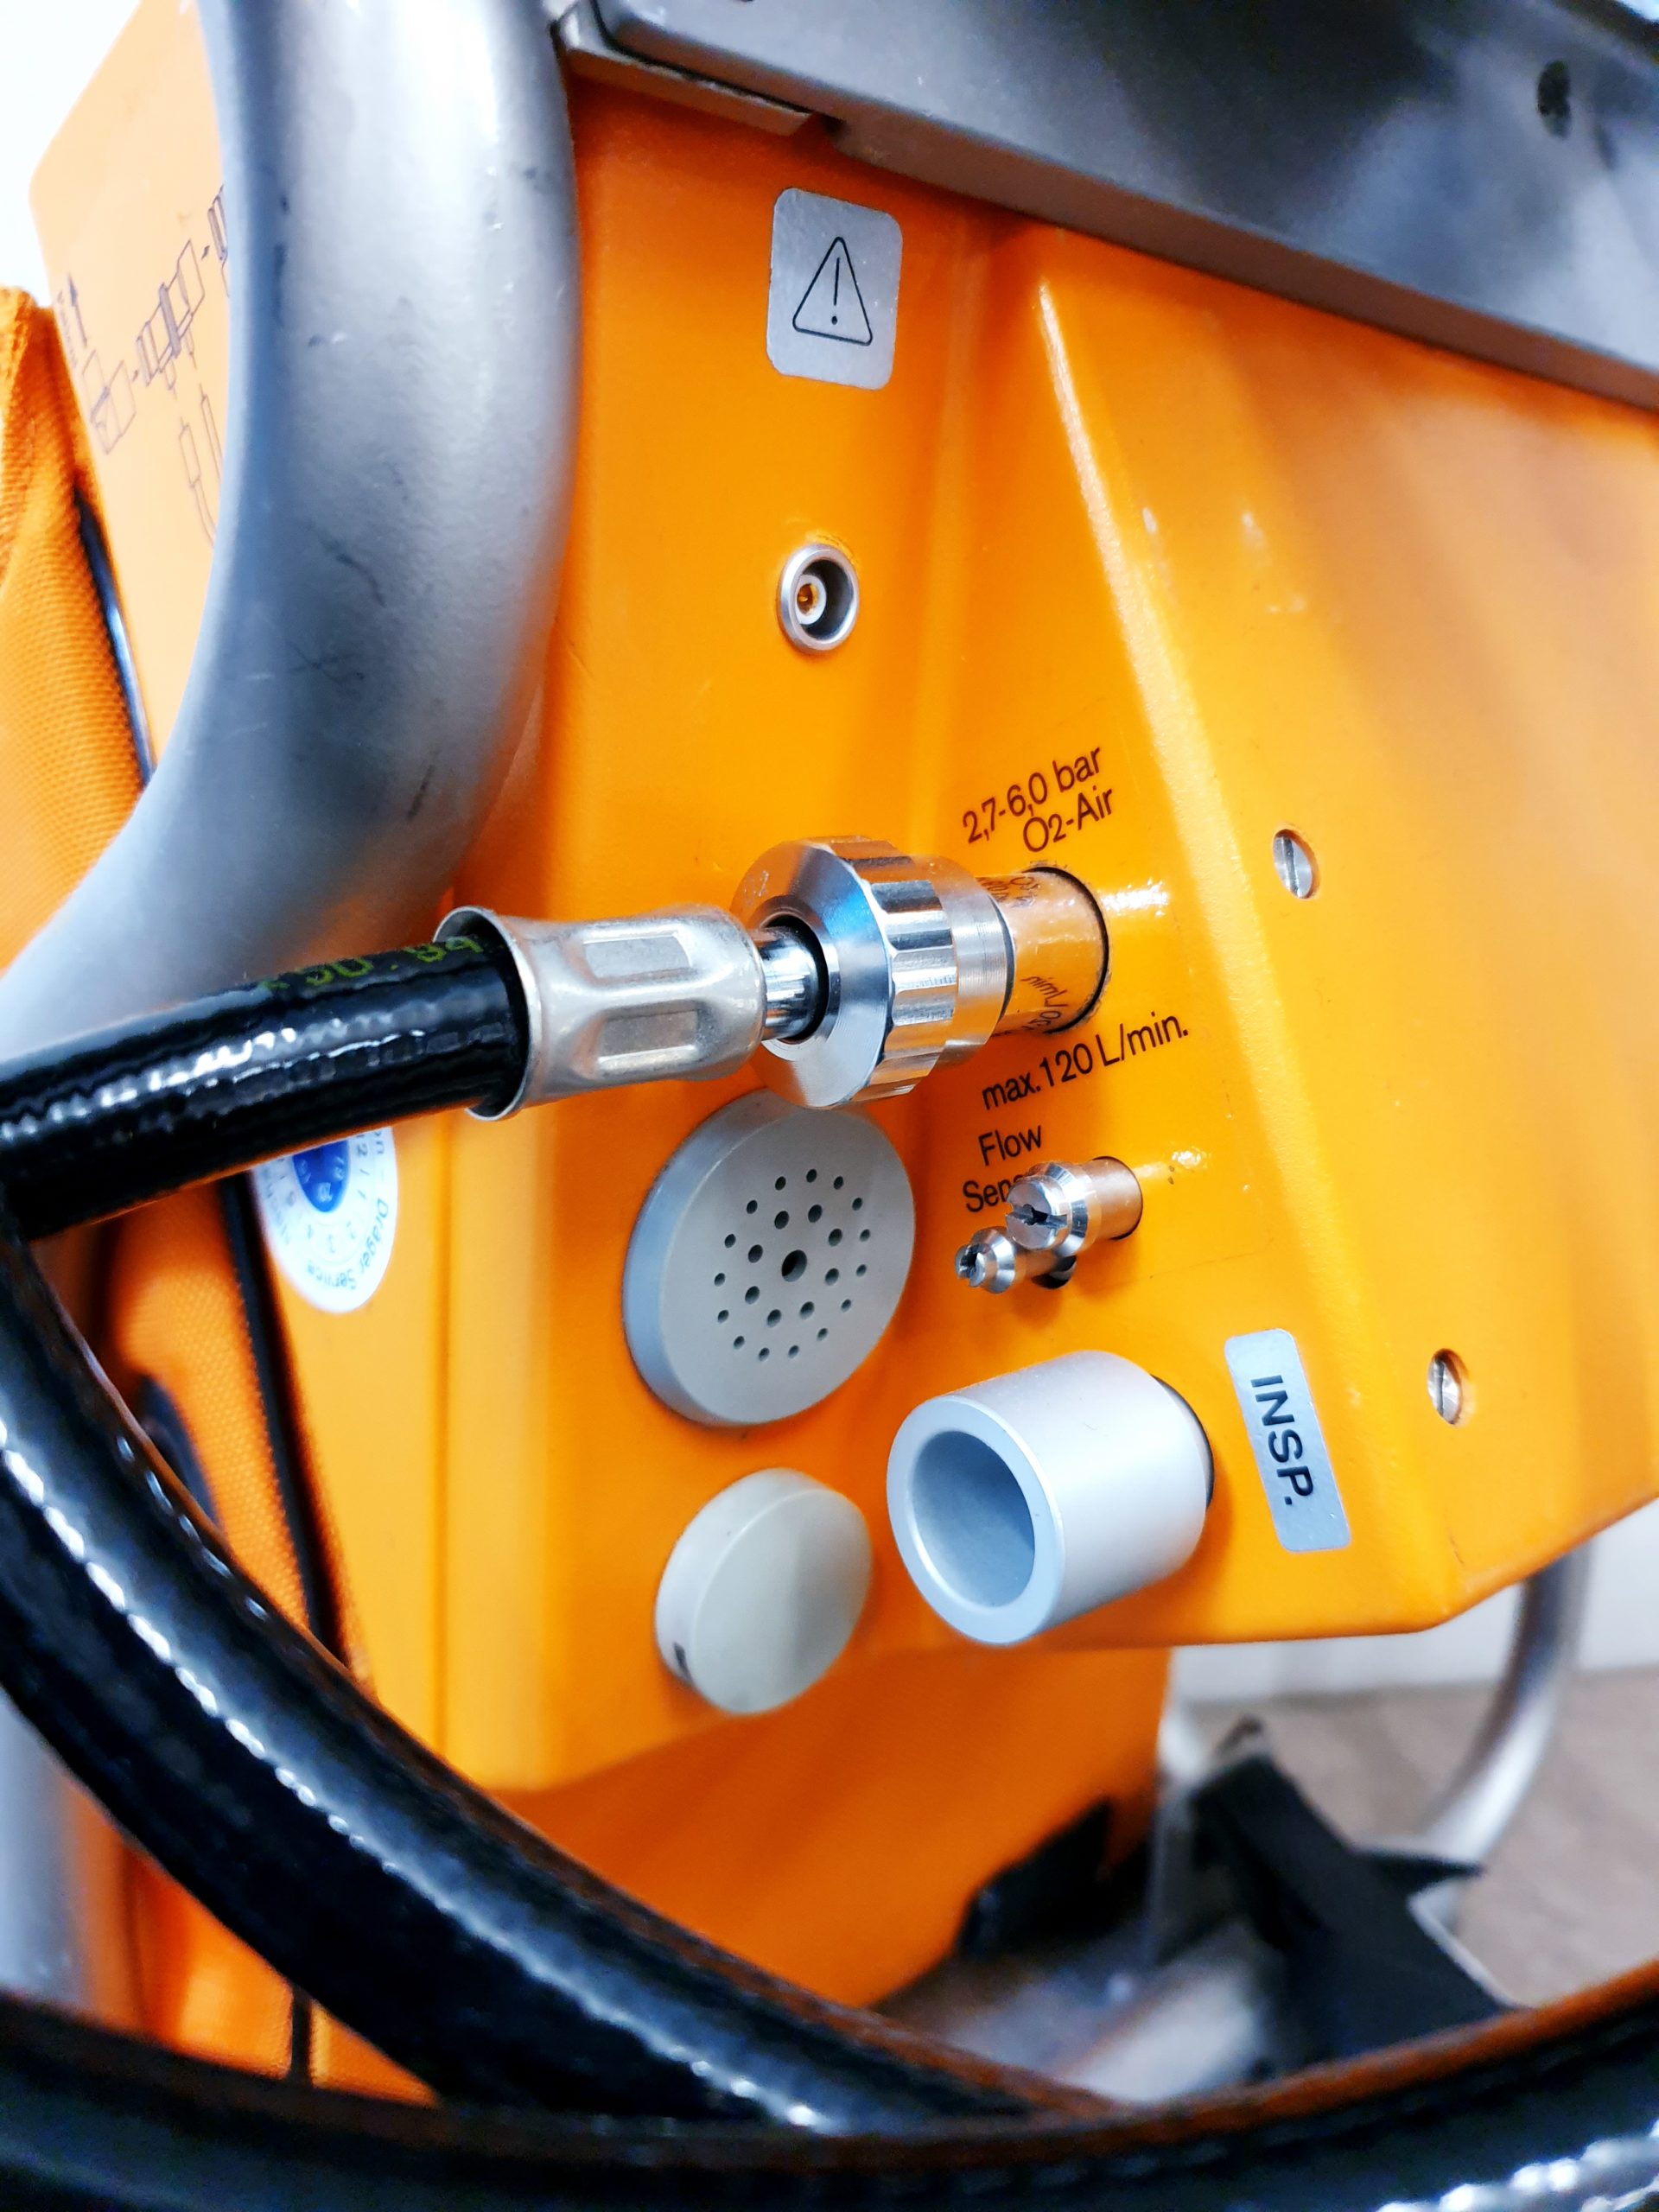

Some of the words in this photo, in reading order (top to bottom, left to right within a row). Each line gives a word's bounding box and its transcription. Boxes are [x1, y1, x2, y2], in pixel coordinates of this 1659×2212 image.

[962, 772, 1048, 843] 2,7-6,0
[1052, 747, 1100, 793] bar
[1022, 785, 1113, 852] O2-Air
[978, 1125, 1041, 1166] Flow
[962, 1174, 1024, 1213] Sen
[1250, 1375, 1314, 1505] INSP.
